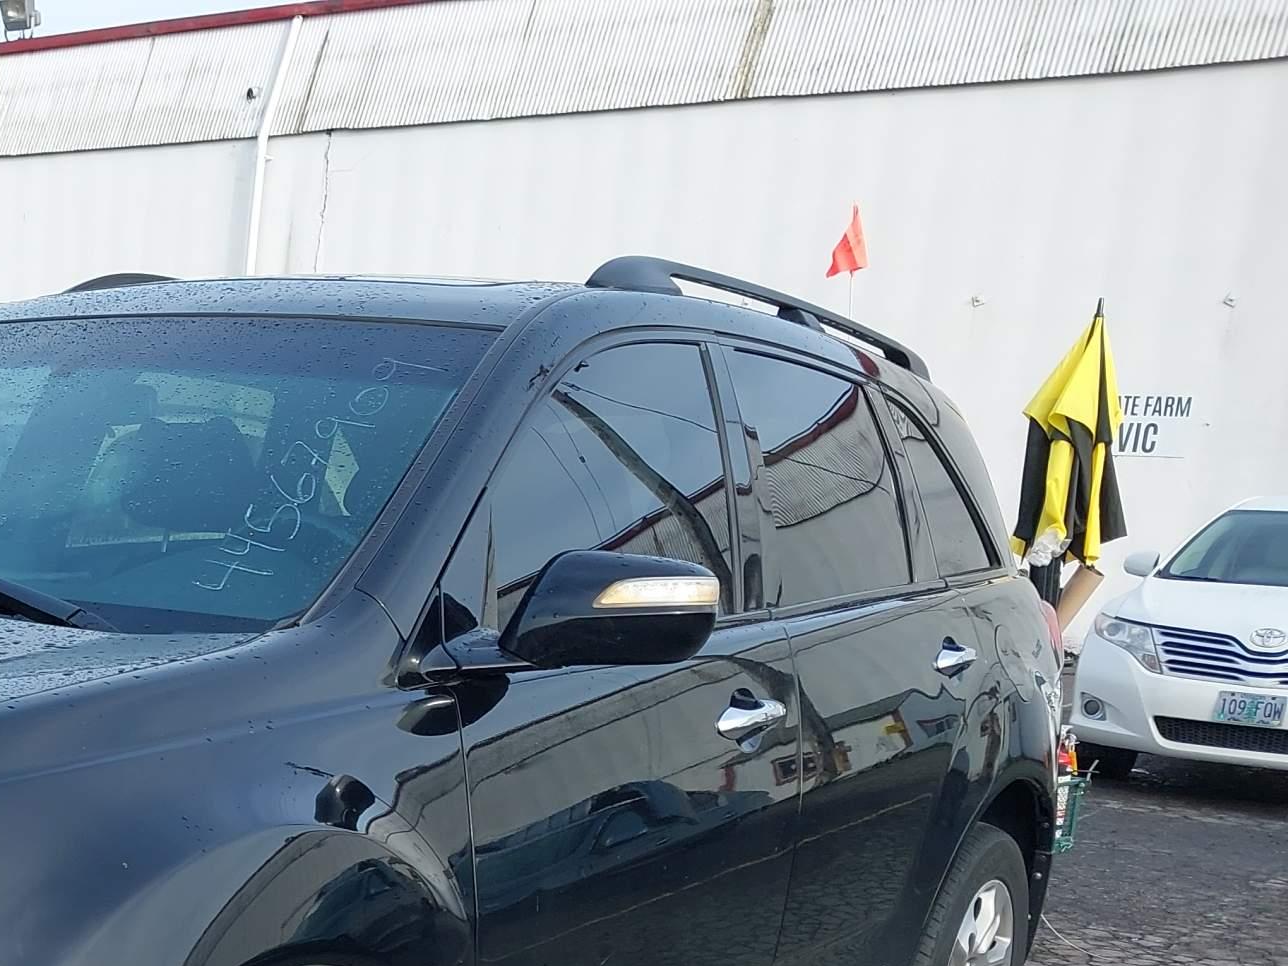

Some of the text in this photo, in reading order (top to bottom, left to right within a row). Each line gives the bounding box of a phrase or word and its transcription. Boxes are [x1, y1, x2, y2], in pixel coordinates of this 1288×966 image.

[1143, 396, 1192, 417] FARM
[1118, 422, 1159, 453] VIC
[192, 357, 449, 591] 44567909
[1220, 698, 1247, 716] 109
